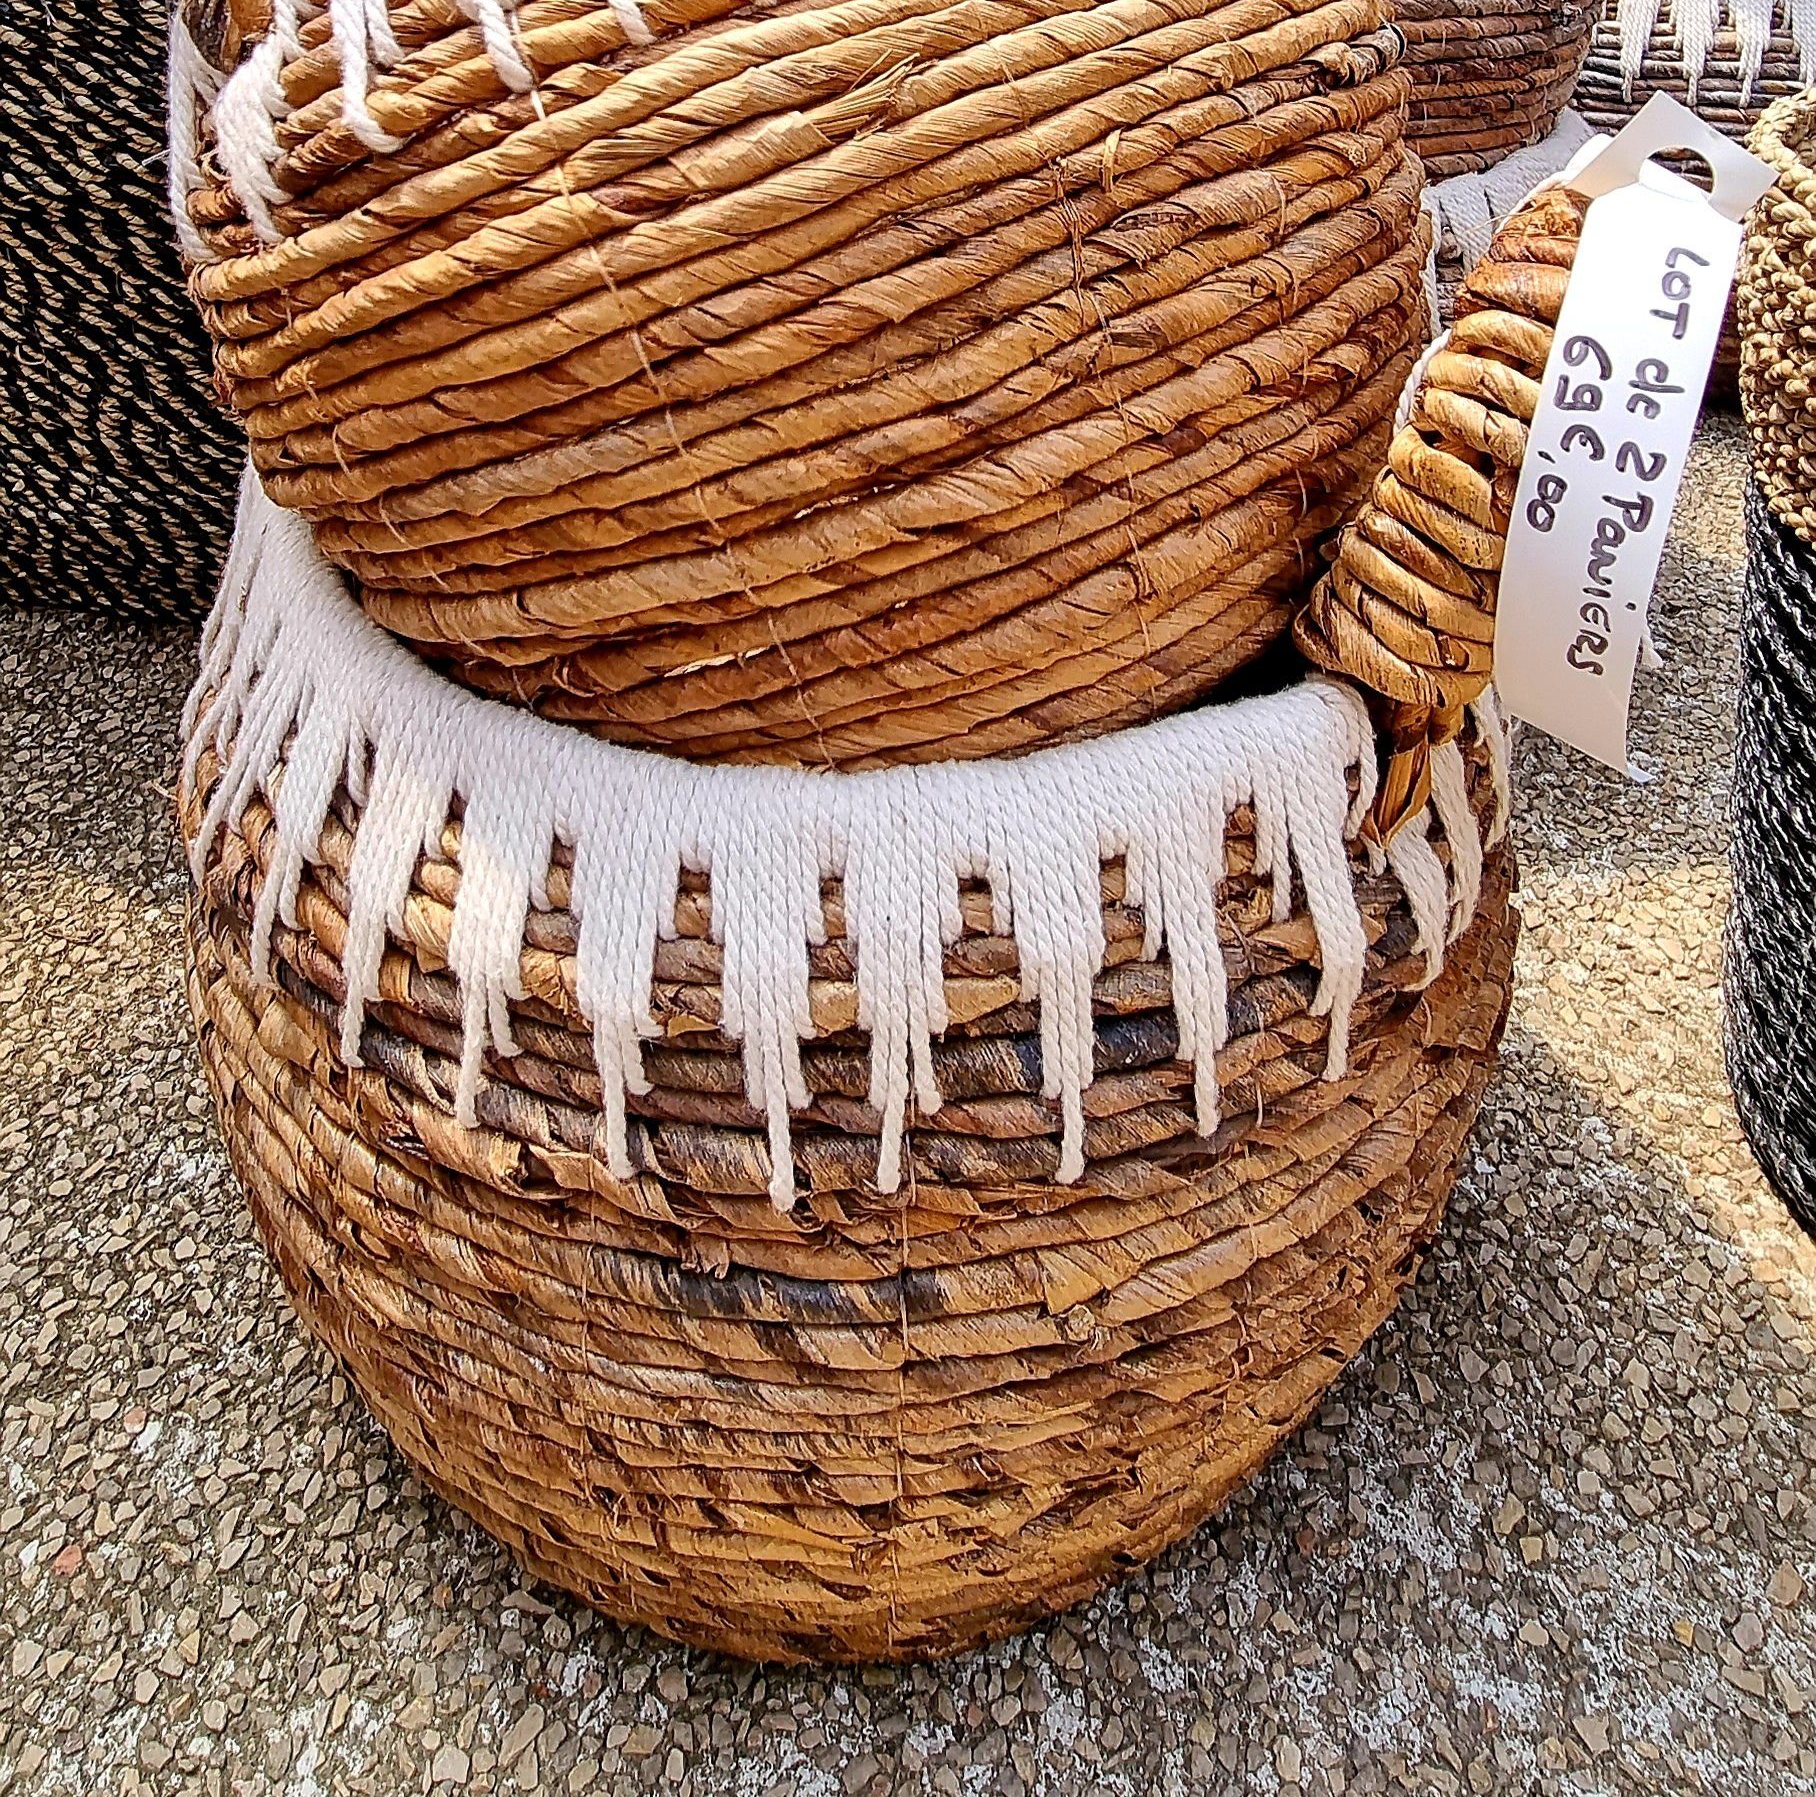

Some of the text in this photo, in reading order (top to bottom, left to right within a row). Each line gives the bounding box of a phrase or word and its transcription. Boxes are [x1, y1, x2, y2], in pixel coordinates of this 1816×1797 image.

[1649, 245, 1710, 341] LOT
[1625, 356, 1685, 420] de
[1614, 439, 1668, 483] 2
